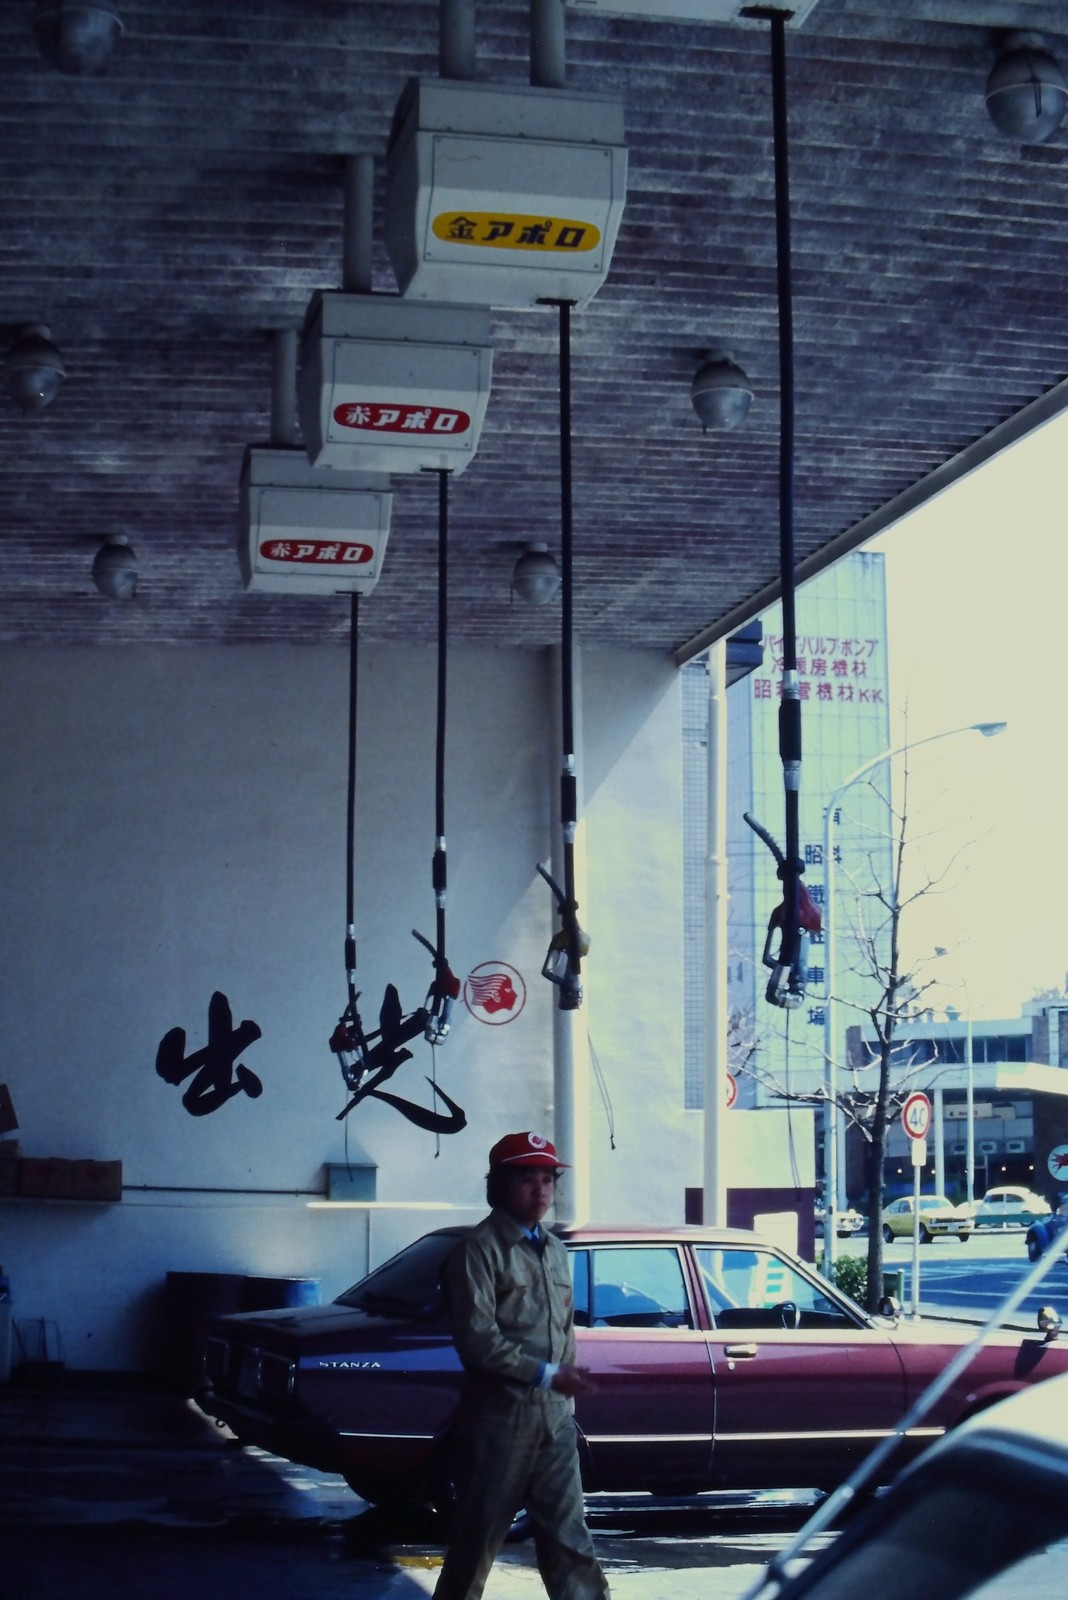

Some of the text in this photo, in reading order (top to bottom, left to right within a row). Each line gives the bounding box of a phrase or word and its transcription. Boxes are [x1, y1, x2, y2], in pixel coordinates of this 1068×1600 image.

[446, 216, 586, 248] 金アポロ
[346, 405, 459, 431] 赤アポロ
[270, 542, 364, 561] 赤アポロ
[910, 1106, 926, 1128] 40
